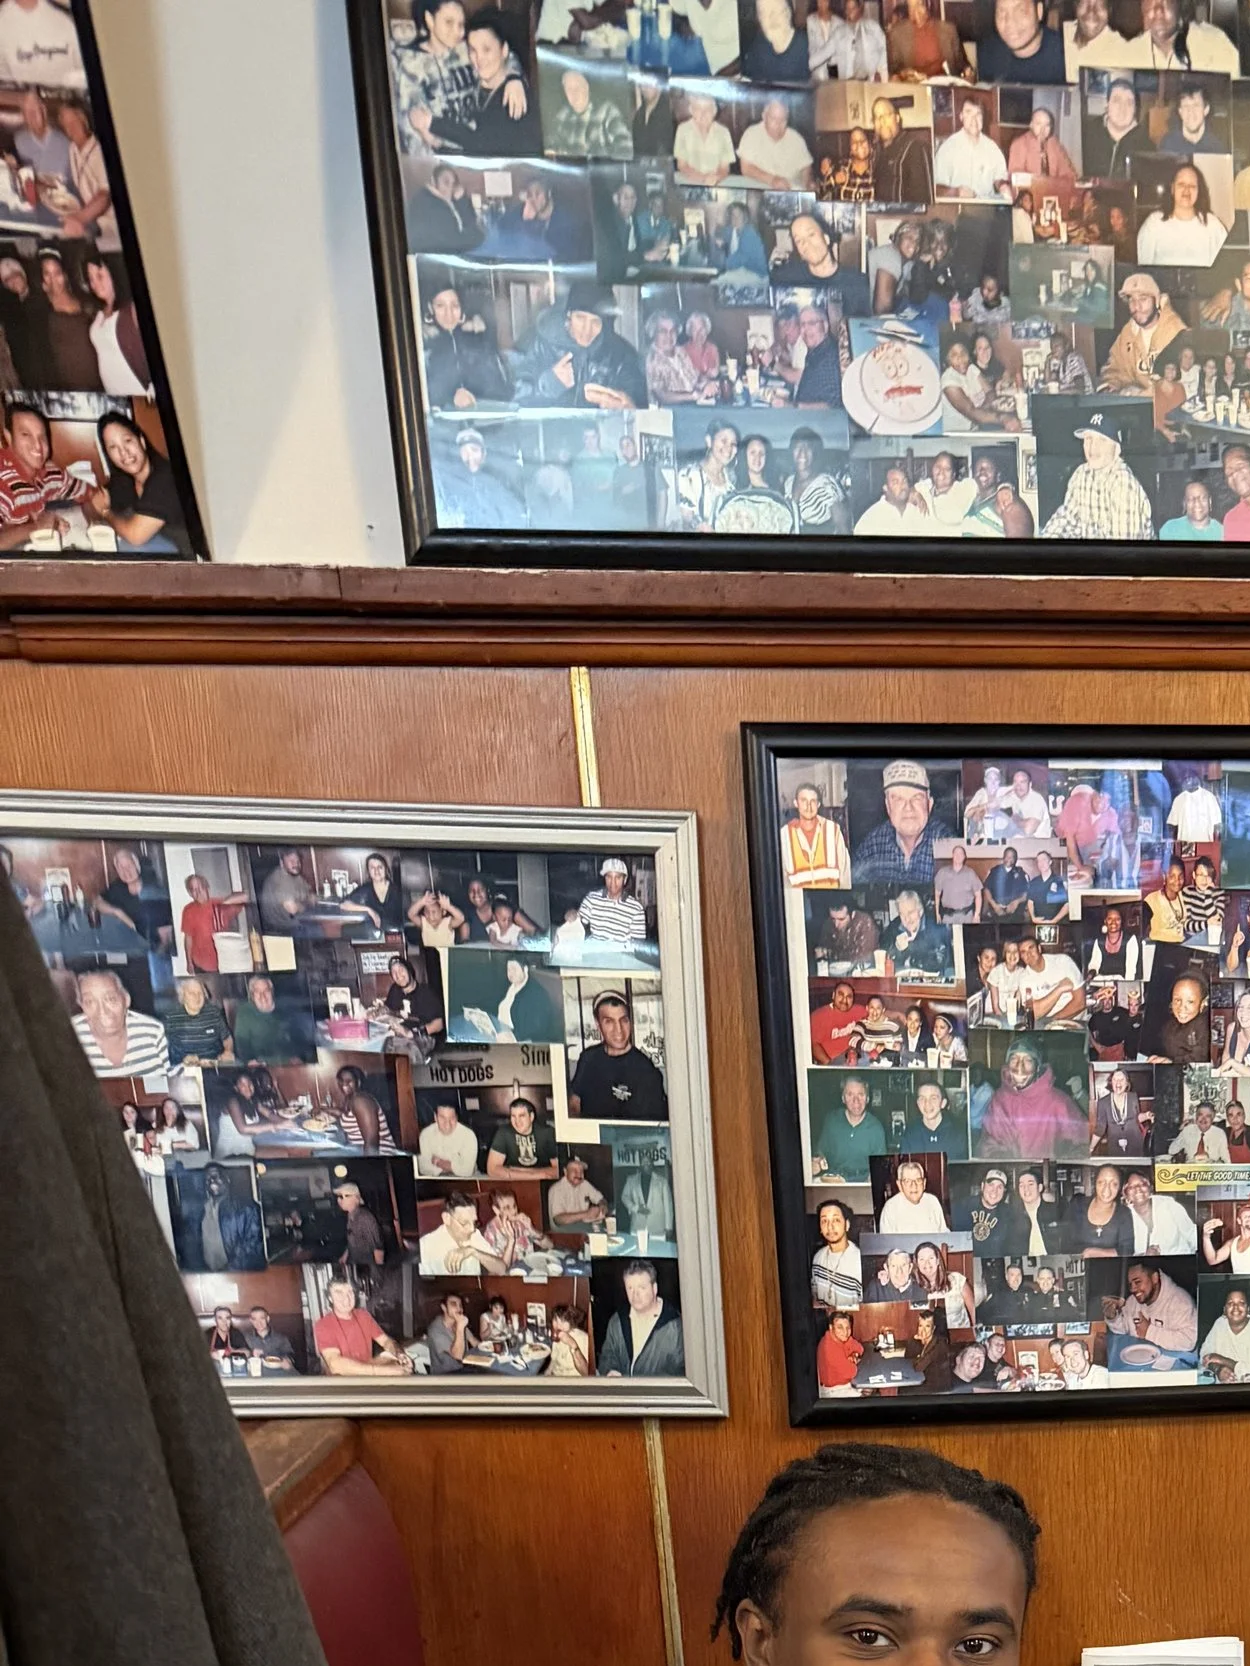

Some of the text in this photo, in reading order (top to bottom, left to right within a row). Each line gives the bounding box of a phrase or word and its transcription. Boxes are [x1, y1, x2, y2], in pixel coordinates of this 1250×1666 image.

[430, 1065, 495, 1084] HOT DOGS
[1186, 1170, 1198, 1181] LET
[1198, 1170, 1211, 1181] THE
[1213, 1170, 1232, 1181] GOOD
[971, 1210, 998, 1229] POLO
